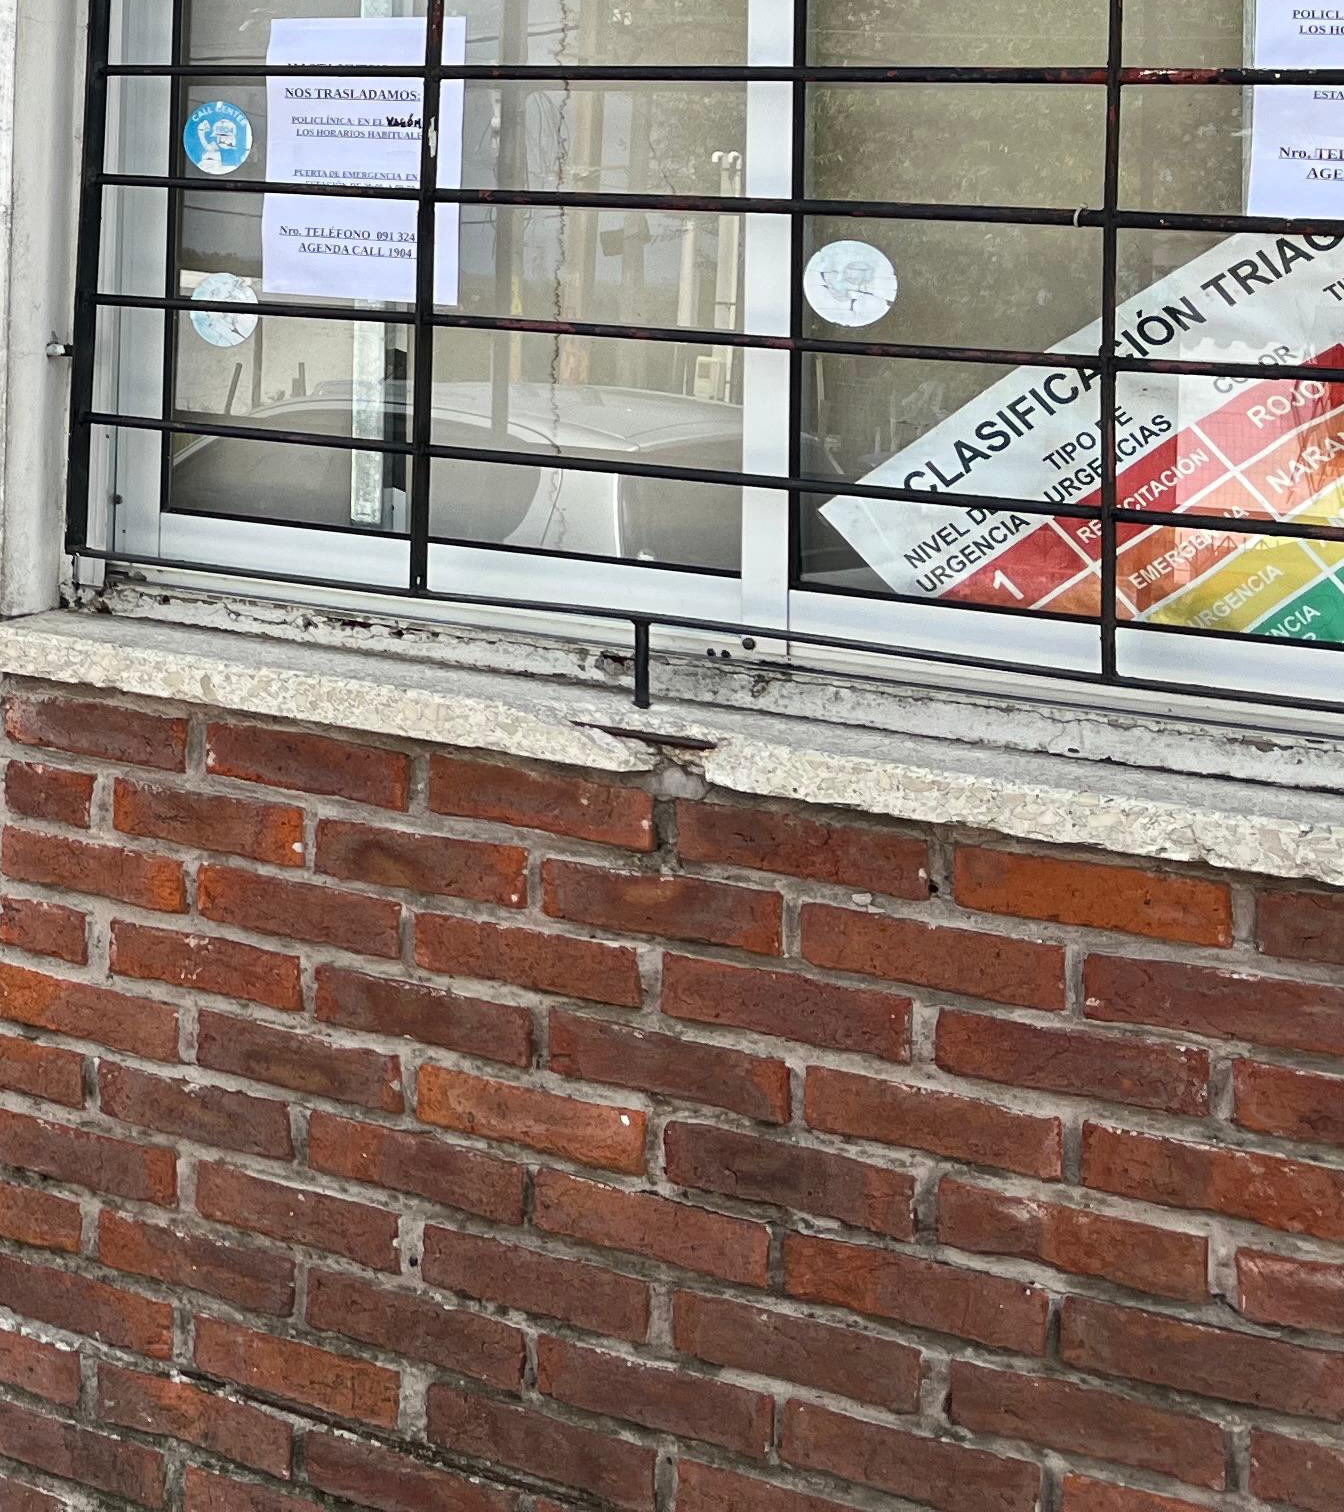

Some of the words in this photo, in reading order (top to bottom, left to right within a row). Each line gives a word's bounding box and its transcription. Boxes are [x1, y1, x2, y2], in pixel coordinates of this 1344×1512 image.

[1299, 25, 1326, 34] LOS
[285, 88, 311, 99] NOS
[315, 89, 421, 101] TRASLADAMOS:
[192, 107, 214, 122] CALL
[296, 129, 314, 137] LOS
[316, 130, 366, 139] HORARIOS
[342, 171, 402, 180] EMERGENCIA
[299, 242, 349, 255] AGENDA
[351, 245, 385, 257] CALL
[388, 247, 412, 258] 1904
[305, 226, 371, 240] TELÉFONO
[376, 231, 394, 242] 091
[903, 296, 1207, 493] CLASIFICIÓN
[1246, 380, 1326, 429] ROJO
[1042, 432, 1096, 470] TIPO
[1094, 406, 1133, 431] E
[1043, 414, 1172, 504] URGECIAS
[1266, 432, 1344, 494] NARA
[1076, 448, 1210, 543] RECITACIÓN
[903, 522, 971, 569] NIVEL
[916, 514, 1031, 593] URGENCIA
[992, 569, 1025, 601] 1
